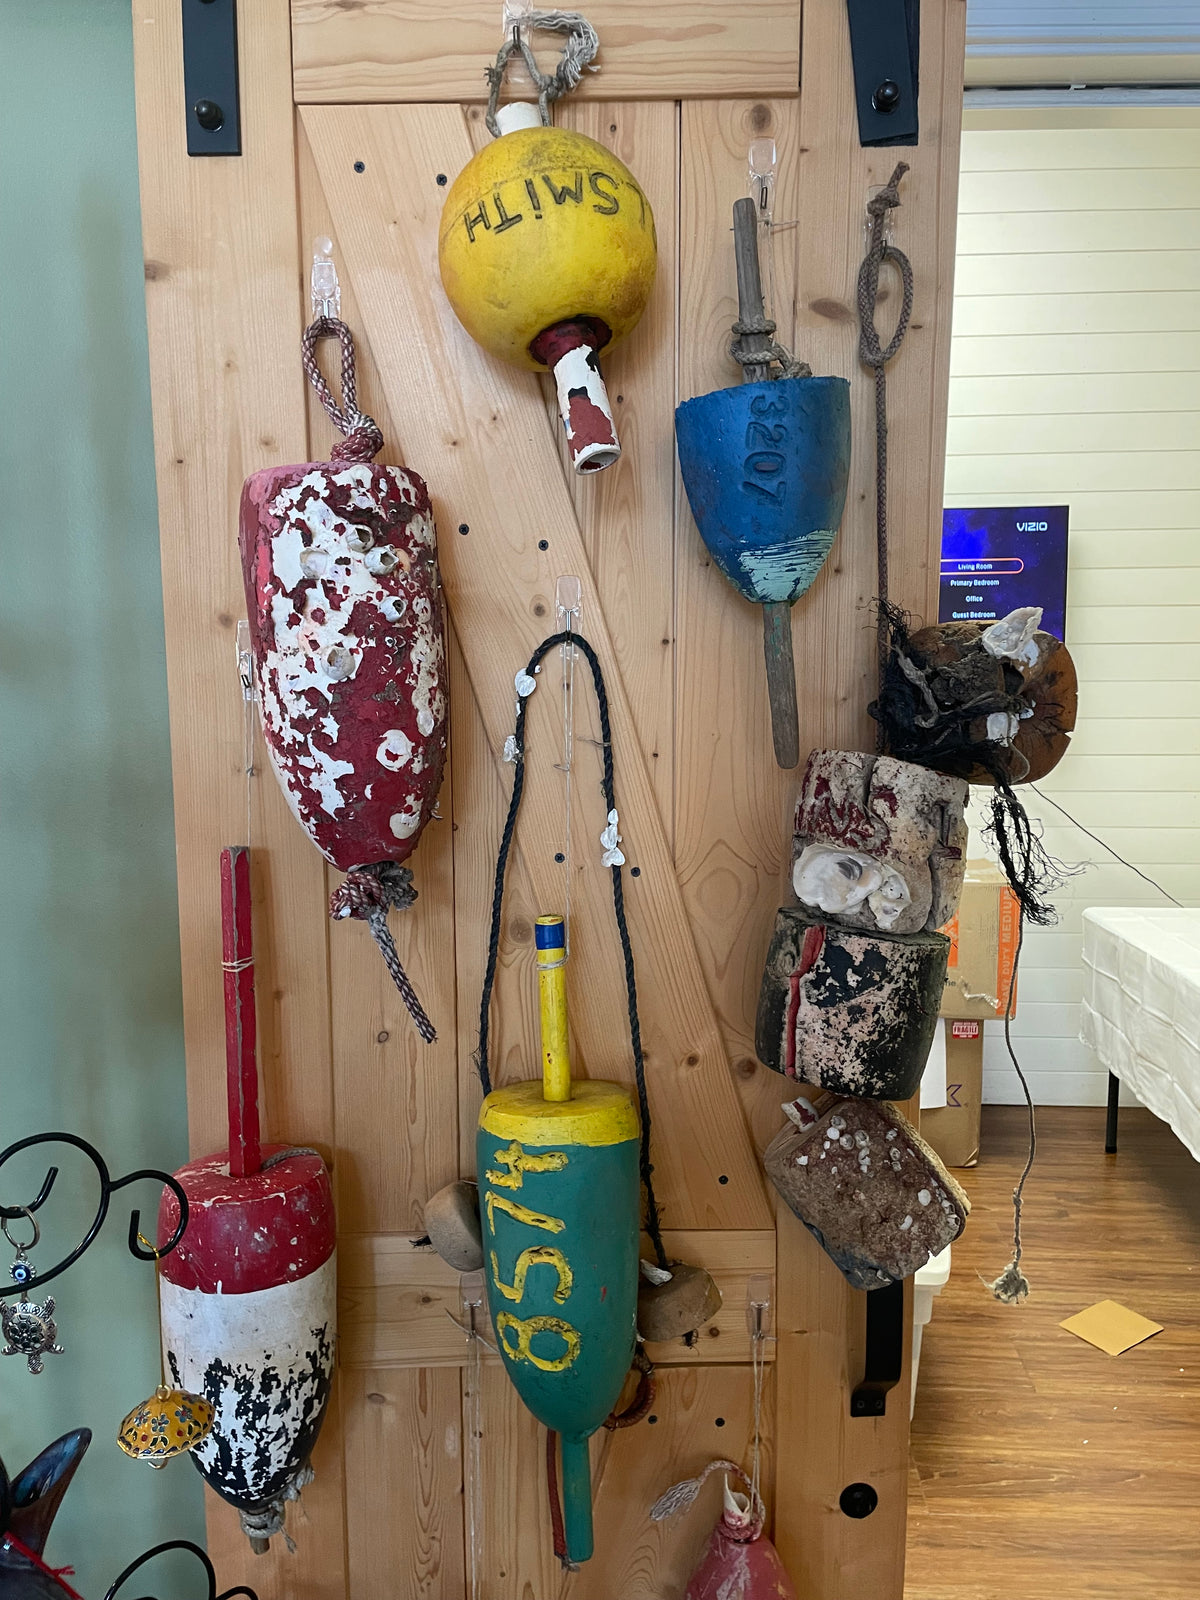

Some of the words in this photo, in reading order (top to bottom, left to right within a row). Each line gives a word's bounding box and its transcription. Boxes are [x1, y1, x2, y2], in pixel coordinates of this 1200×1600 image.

[741, 395, 789, 506] 3207
[1016, 521, 1048, 532] VIZIO
[958, 563, 975, 571] Living
[950, 579, 973, 587] Primary
[952, 611, 969, 619] Guest
[1002, 889, 1013, 943] MEDIUM
[1002, 947, 1010, 975] DUTY
[953, 1025, 978, 1035] FRAGILE
[485, 1139, 581, 1372] 8574
